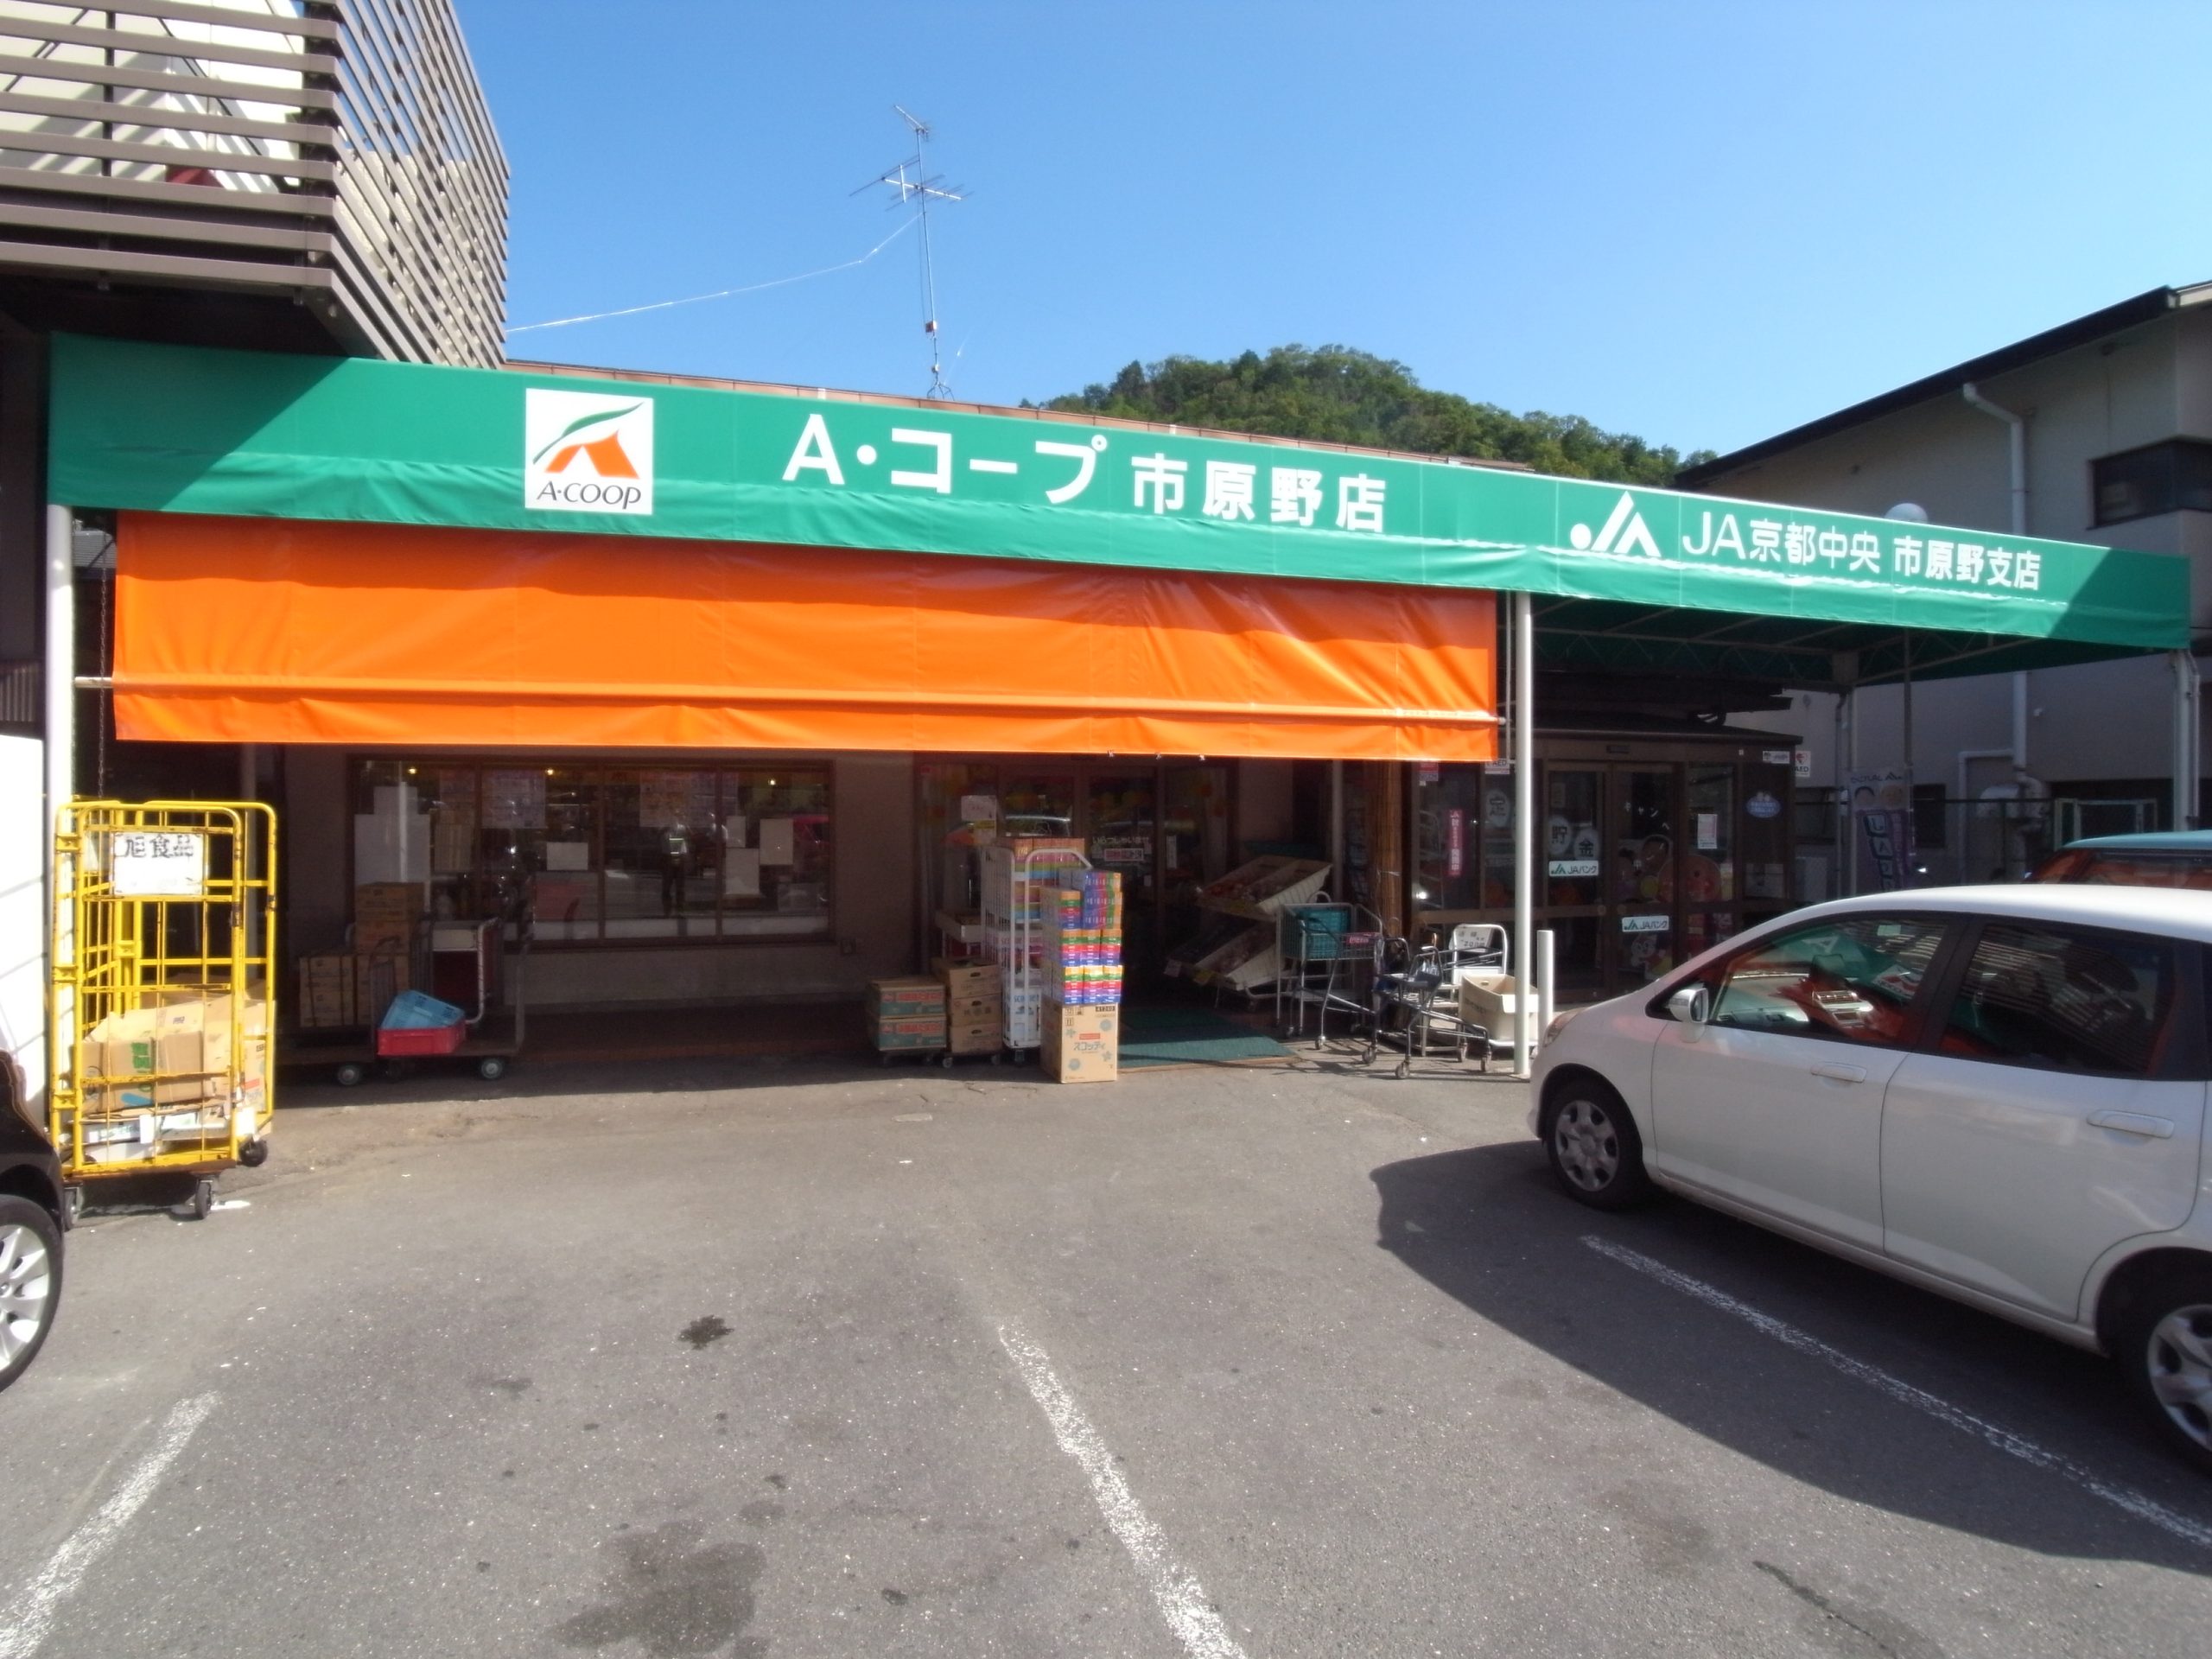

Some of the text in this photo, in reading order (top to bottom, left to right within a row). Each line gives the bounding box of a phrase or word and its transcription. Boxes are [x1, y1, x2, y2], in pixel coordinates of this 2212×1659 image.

[782, 413, 1388, 533] A・コープ 市原野店
[1682, 512, 2042, 591] JA京都中央 市原野支店
[1567, 865, 1597, 874] JAバンク
[1642, 920, 1668, 930] JAバンク
